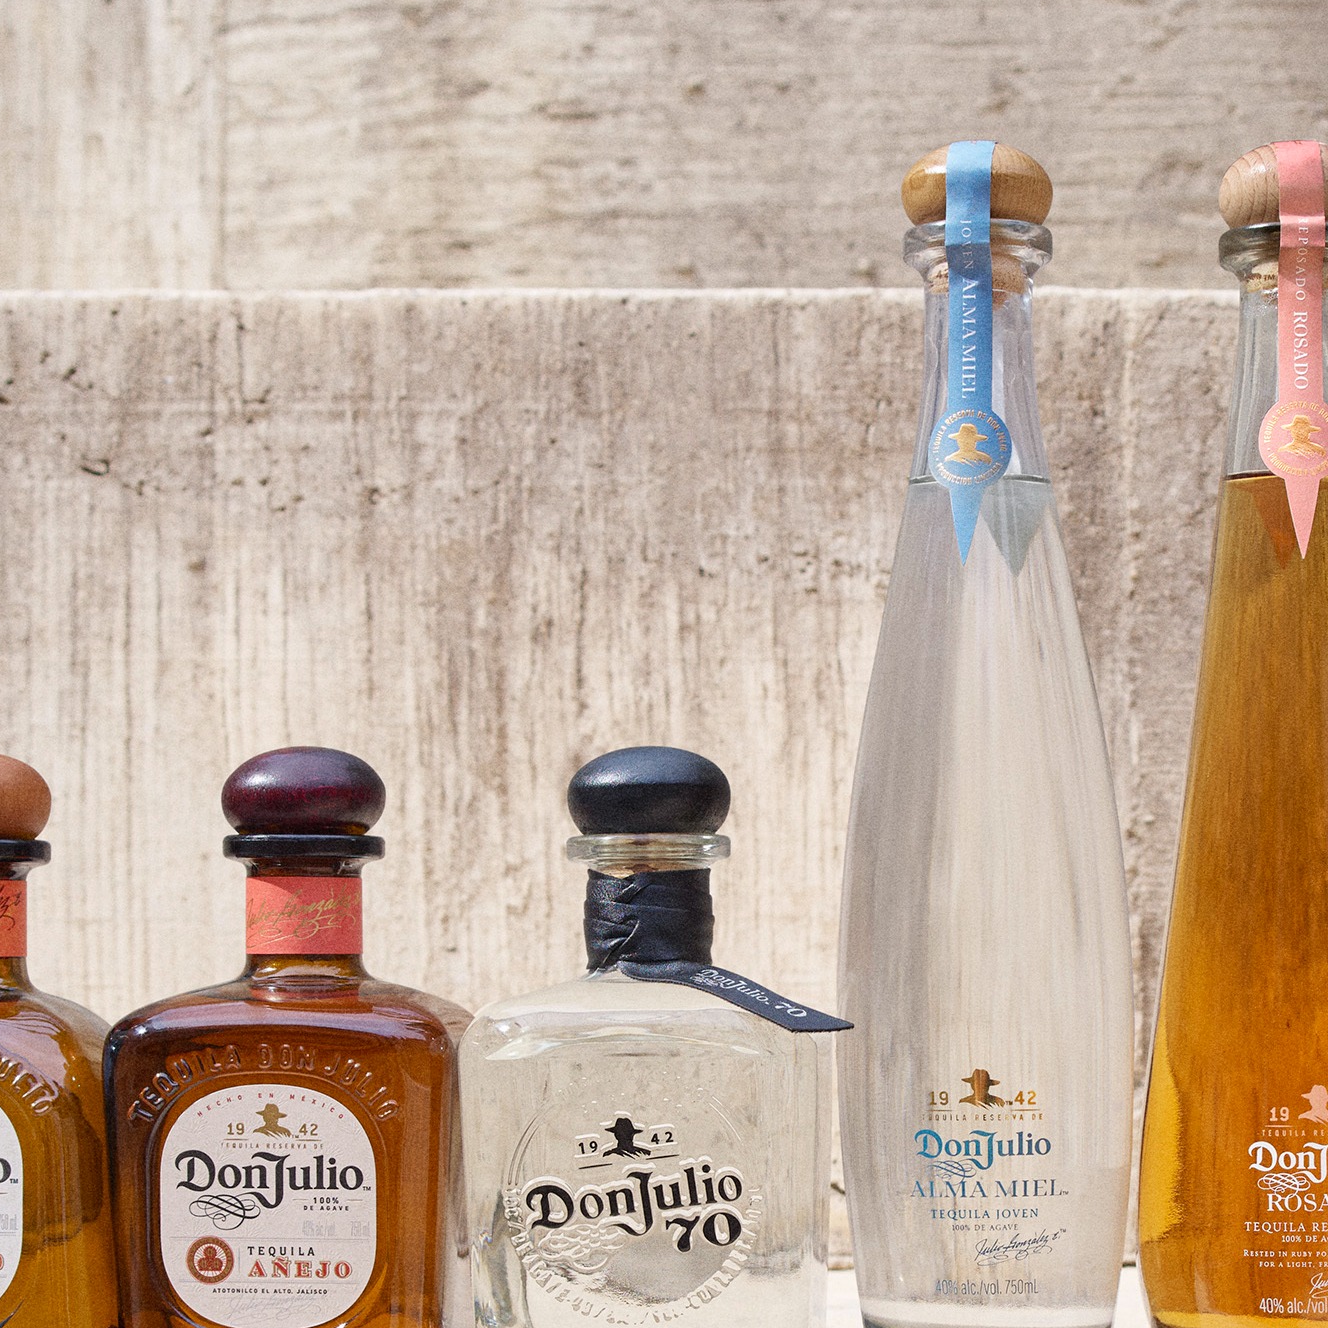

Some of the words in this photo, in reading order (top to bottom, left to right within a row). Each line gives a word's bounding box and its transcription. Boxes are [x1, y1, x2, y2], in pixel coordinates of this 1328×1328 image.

[960, 219, 974, 269] JOVEN
[1295, 217, 1309, 301] REPOSADO
[962, 277, 979, 340] ALMA
[1293, 311, 1309, 390] ROSADO
[962, 344, 976, 399] MIEL
[774, 1001, 808, 1018] 70
[127, 1043, 242, 1122] TEQUILA
[257, 1043, 316, 1071] DON
[324, 1054, 399, 1121] JULIO
[197, 1095, 243, 1117] HECHO
[929, 1091, 949, 1106] 19
[1014, 1090, 1037, 1105] 42
[1269, 1106, 1290, 1122] 19
[227, 1122, 245, 1136] 19
[299, 1123, 318, 1136] 42
[1261, 1129, 1306, 1137] TEQUILA
[578, 1140, 599, 1155] 19
[651, 1131, 674, 1145] 42
[910, 1179, 988, 1198] ALMA
[995, 1178, 1064, 1198] MIEL
[313, 1197, 339, 1205] 100%
[930, 1209, 990, 1221] TEQUILA
[995, 1208, 1039, 1220] JOVEN
[665, 1212, 742, 1253] 70
[989, 1223, 1019, 1231] AGAVE
[1244, 1221, 1306, 1234] TEQUILA
[1281, 1235, 1302, 1243] 100%
[1305, 1235, 1318, 1243] DE
[247, 1246, 315, 1258] TEQUILA
[247, 1256, 353, 1279] AÑEJO
[935, 1280, 959, 1295] 40%
[1005, 1279, 1039, 1295] 750mL
[1259, 1298, 1284, 1314] 40%
